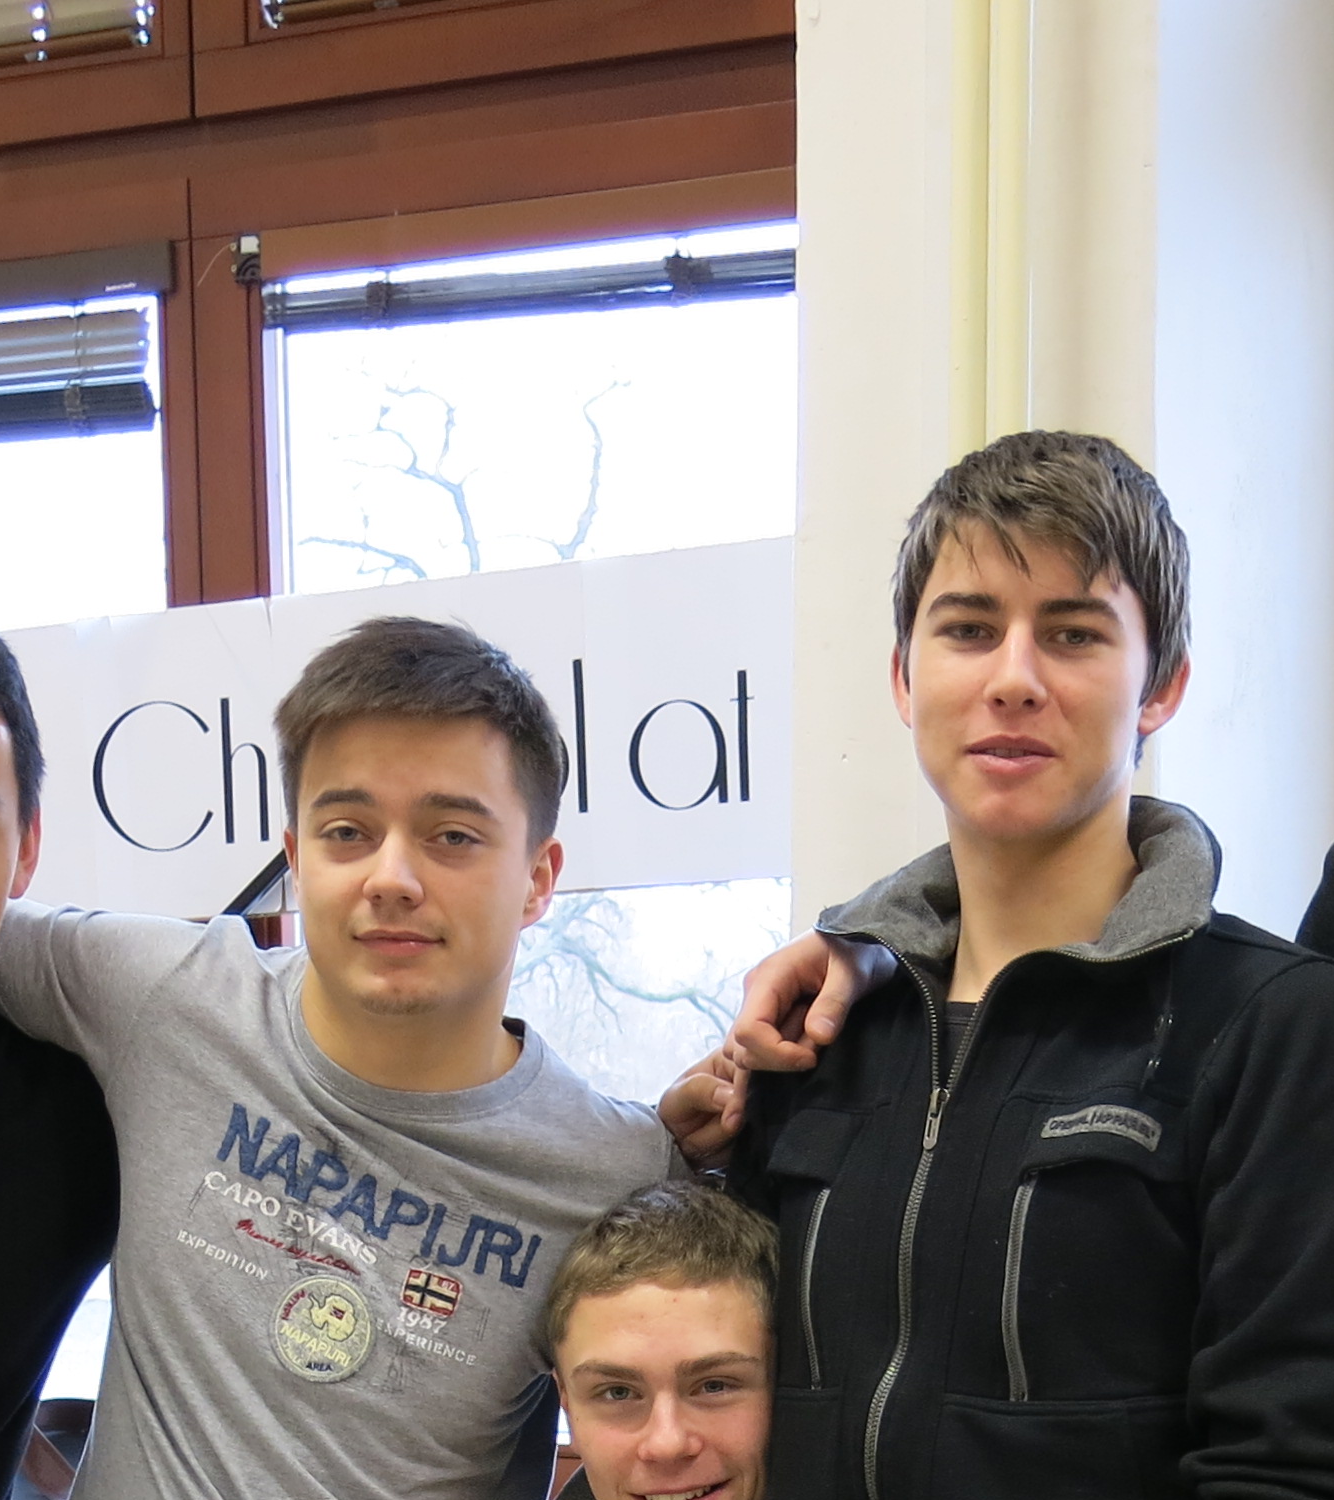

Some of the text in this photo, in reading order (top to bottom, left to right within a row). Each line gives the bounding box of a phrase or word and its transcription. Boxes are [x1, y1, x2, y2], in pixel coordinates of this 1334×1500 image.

[204, 1170, 281, 1217] CAPO
[285, 1207, 378, 1265] EVANS
[216, 1102, 542, 1289] NAPAPIJRI
[176, 1228, 268, 1281] EXPEDITION
[280, 1322, 352, 1367] NAPAPIJRI
[375, 1317, 477, 1366] EXPERIENCE
[396, 1306, 448, 1334] 1987
